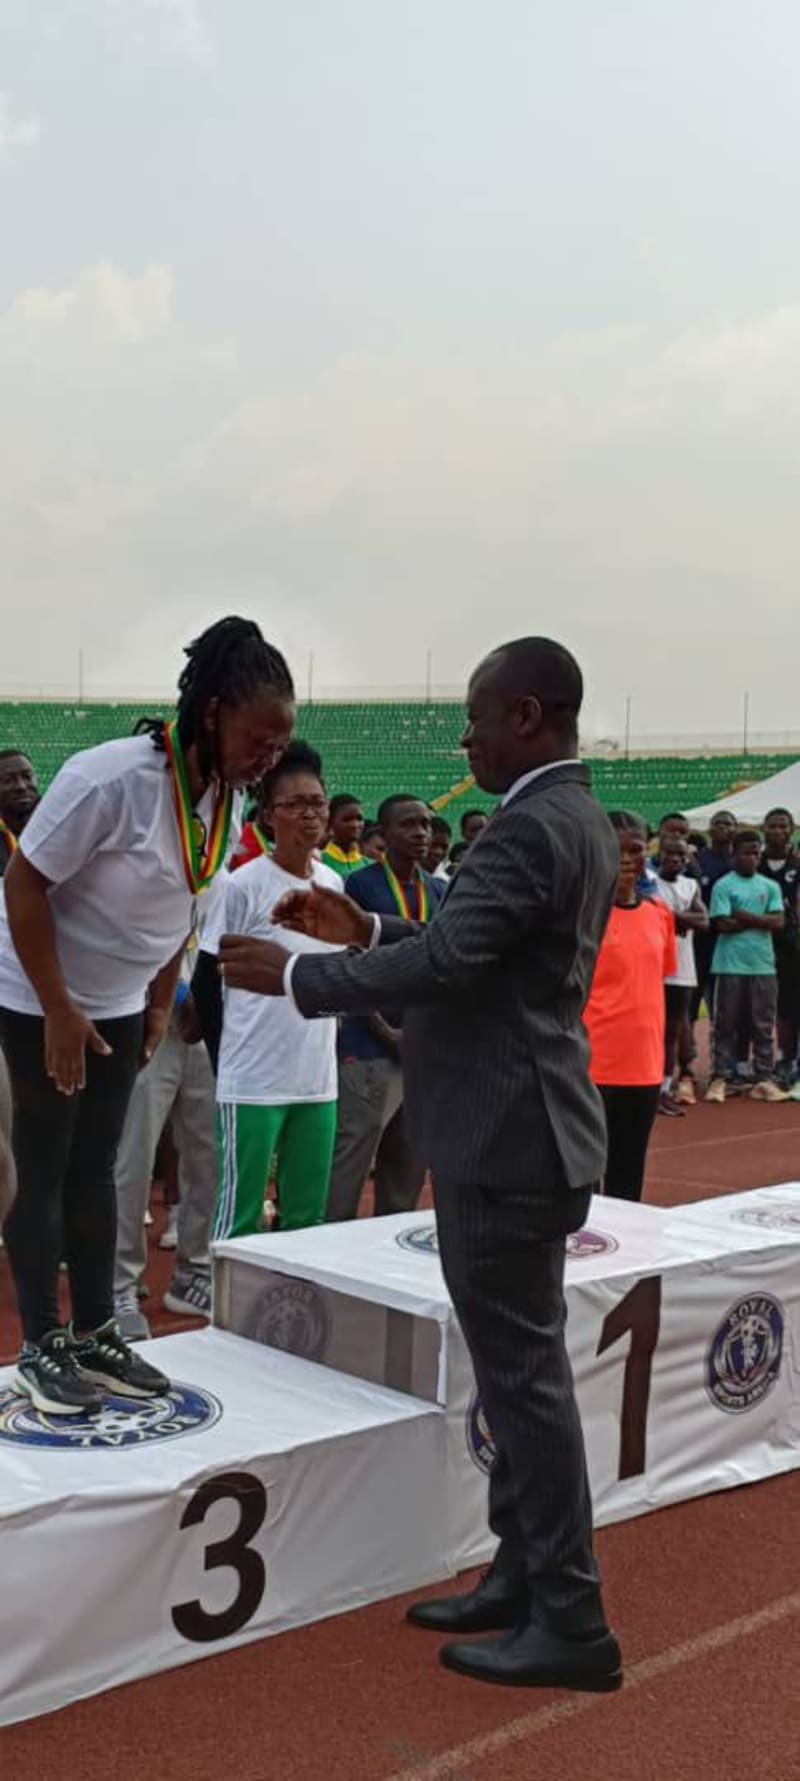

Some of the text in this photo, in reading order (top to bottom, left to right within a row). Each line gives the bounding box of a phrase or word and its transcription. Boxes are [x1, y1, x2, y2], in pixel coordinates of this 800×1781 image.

[728, 1300, 775, 1326] ROYAL
[596, 1275, 662, 1481] 1
[69, 1415, 201, 1446] ROYAL
[171, 1472, 267, 1642] 3
